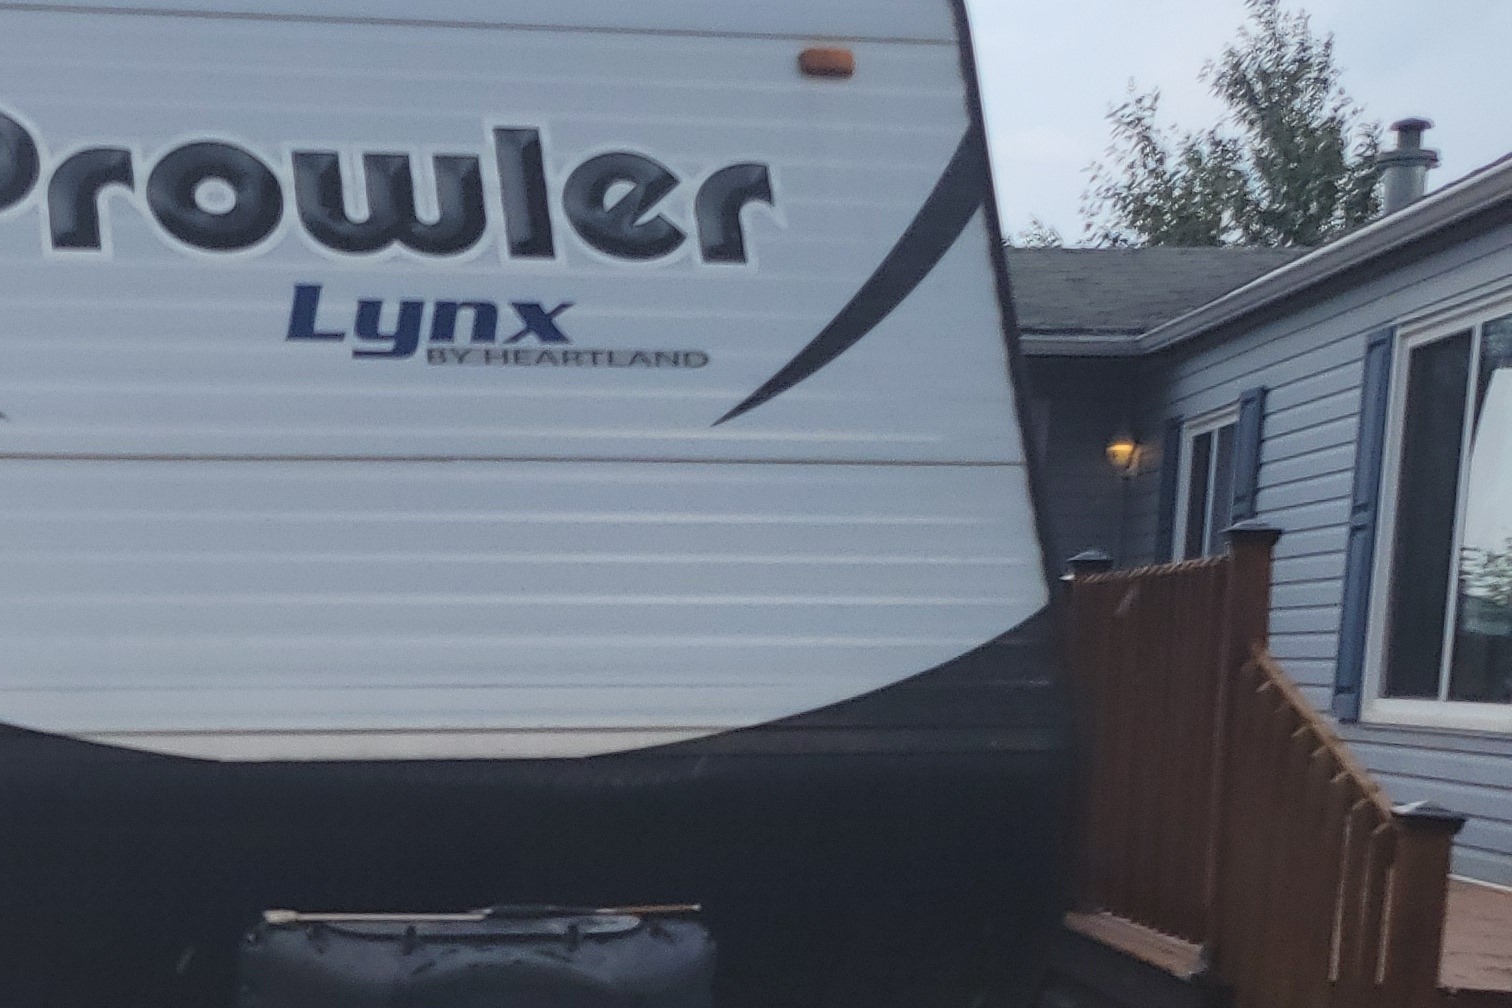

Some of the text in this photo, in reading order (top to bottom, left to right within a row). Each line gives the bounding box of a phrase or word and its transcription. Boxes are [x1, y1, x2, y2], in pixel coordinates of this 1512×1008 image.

[286, 283, 575, 360] Lynx
[426, 348, 710, 369] BY HEARTLAND
